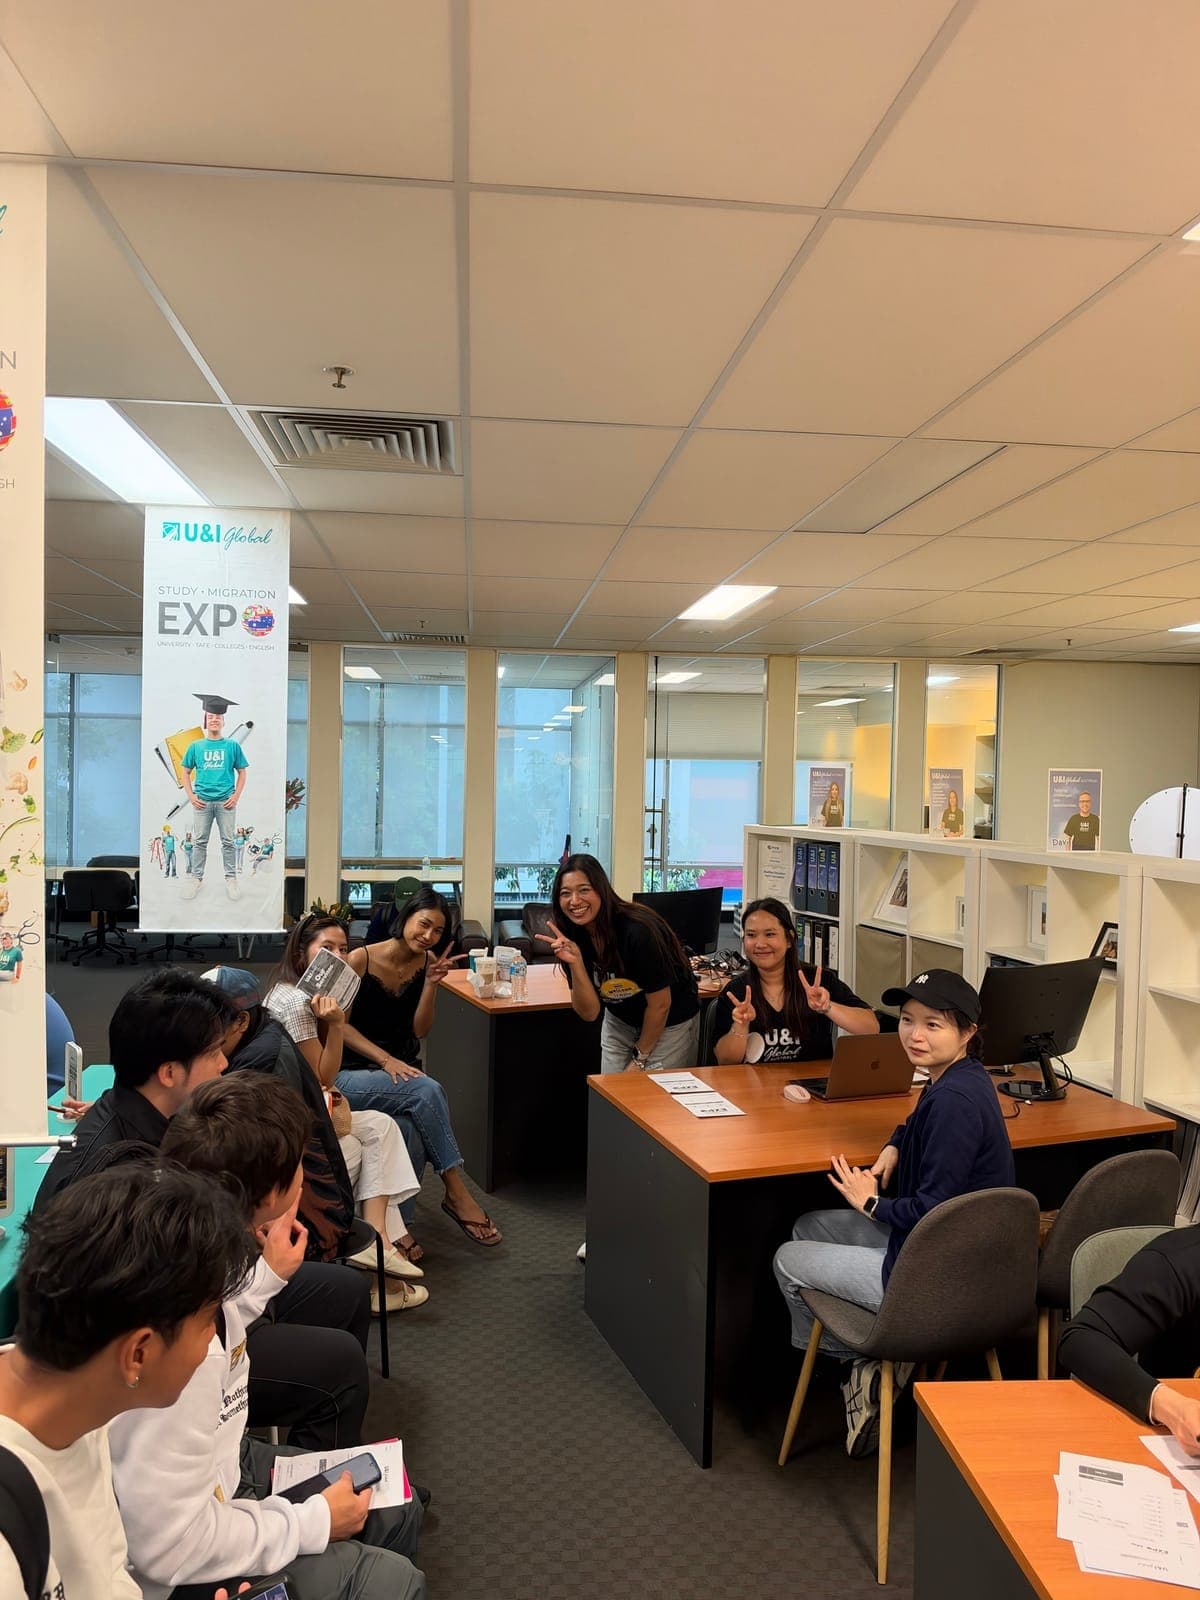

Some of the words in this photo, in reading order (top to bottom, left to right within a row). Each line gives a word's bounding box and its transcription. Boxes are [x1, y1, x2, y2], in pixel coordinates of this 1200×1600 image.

[184, 522, 221, 543] U&I
[223, 526, 273, 550] Global
[158, 585, 198, 596] STUDY
[207, 587, 276, 600] MIGRATION
[157, 641, 191, 649] UNIVERSITY
[214, 642, 245, 650] COLLEGES
[248, 643, 275, 651] ENGLISH
[203, 750, 225, 761] U&I
